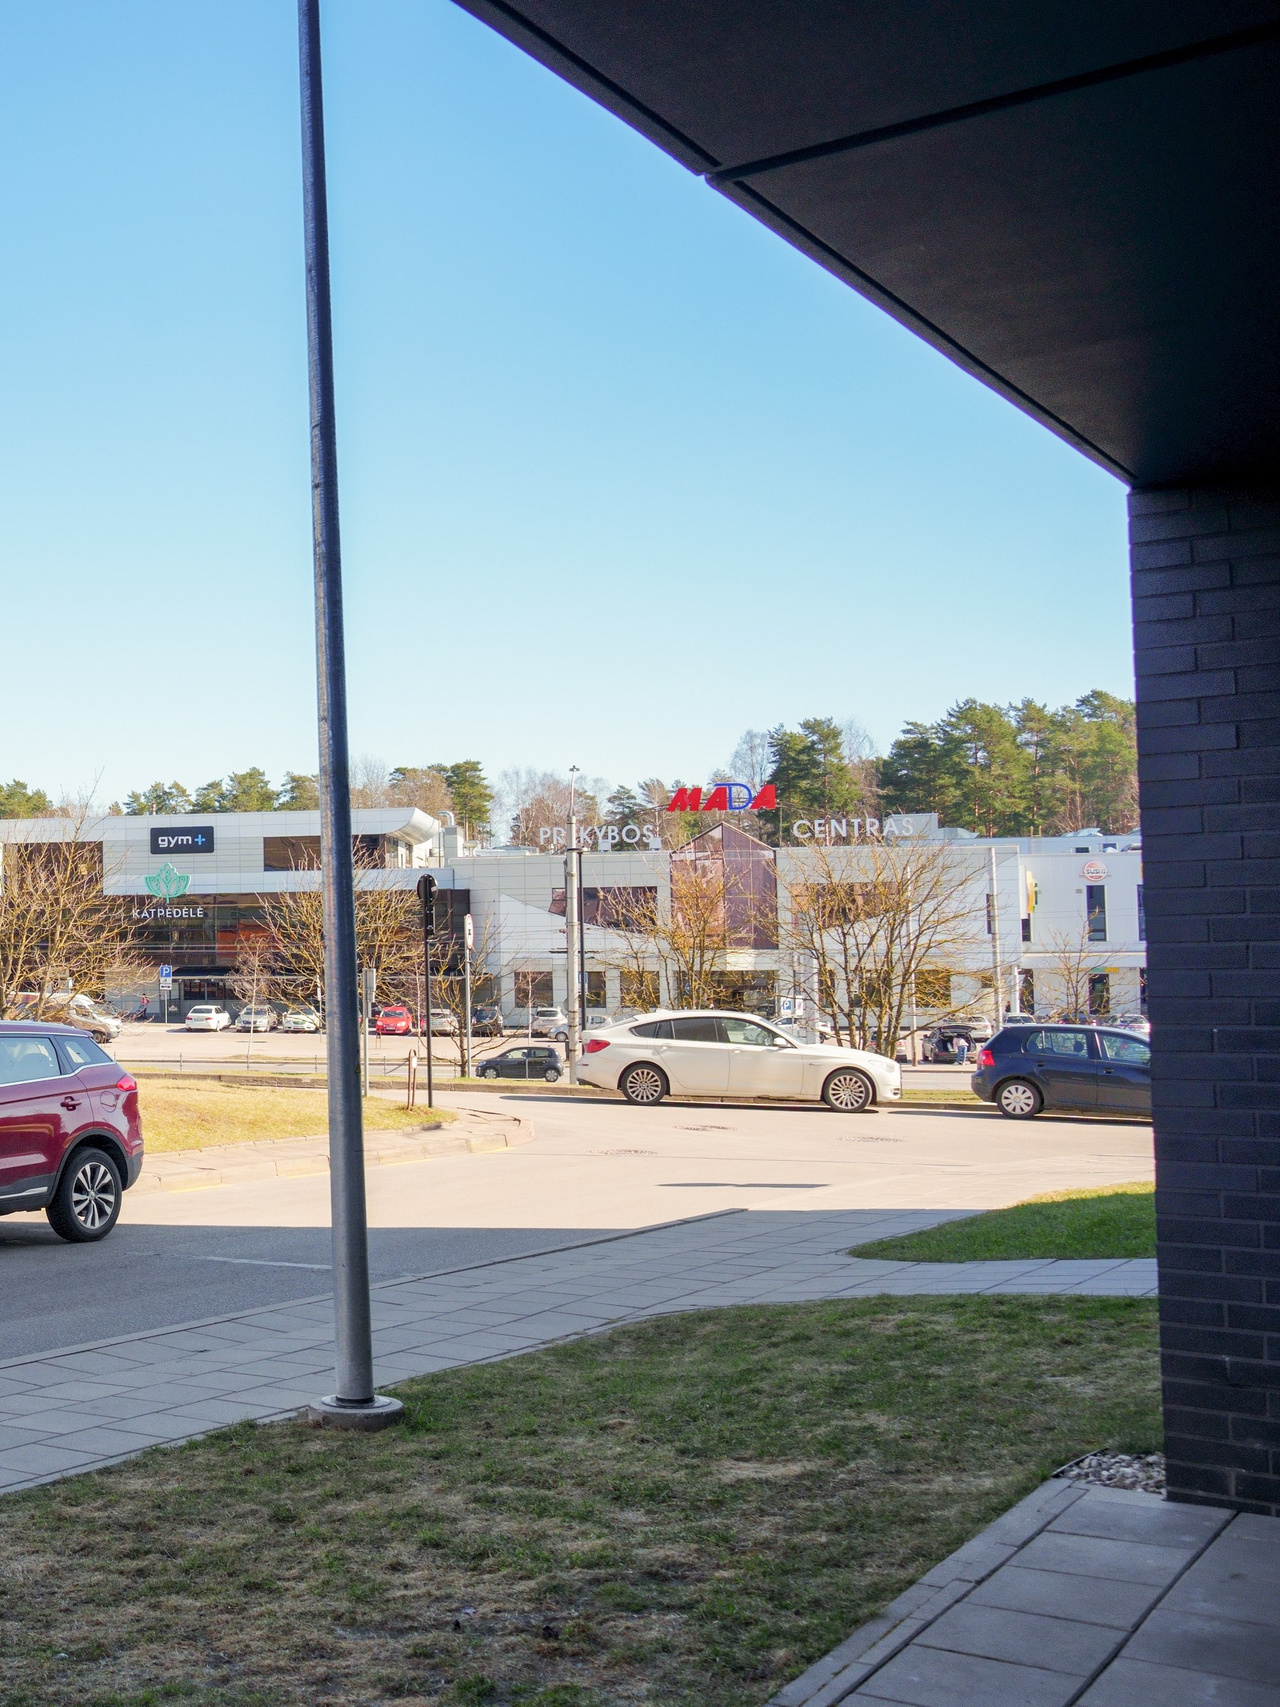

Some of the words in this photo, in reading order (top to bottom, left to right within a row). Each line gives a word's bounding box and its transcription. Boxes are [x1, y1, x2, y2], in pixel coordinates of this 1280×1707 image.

[666, 783, 776, 811] MADA
[540, 825, 655, 845] PRKYBOS
[793, 817, 914, 838] CENTRAS
